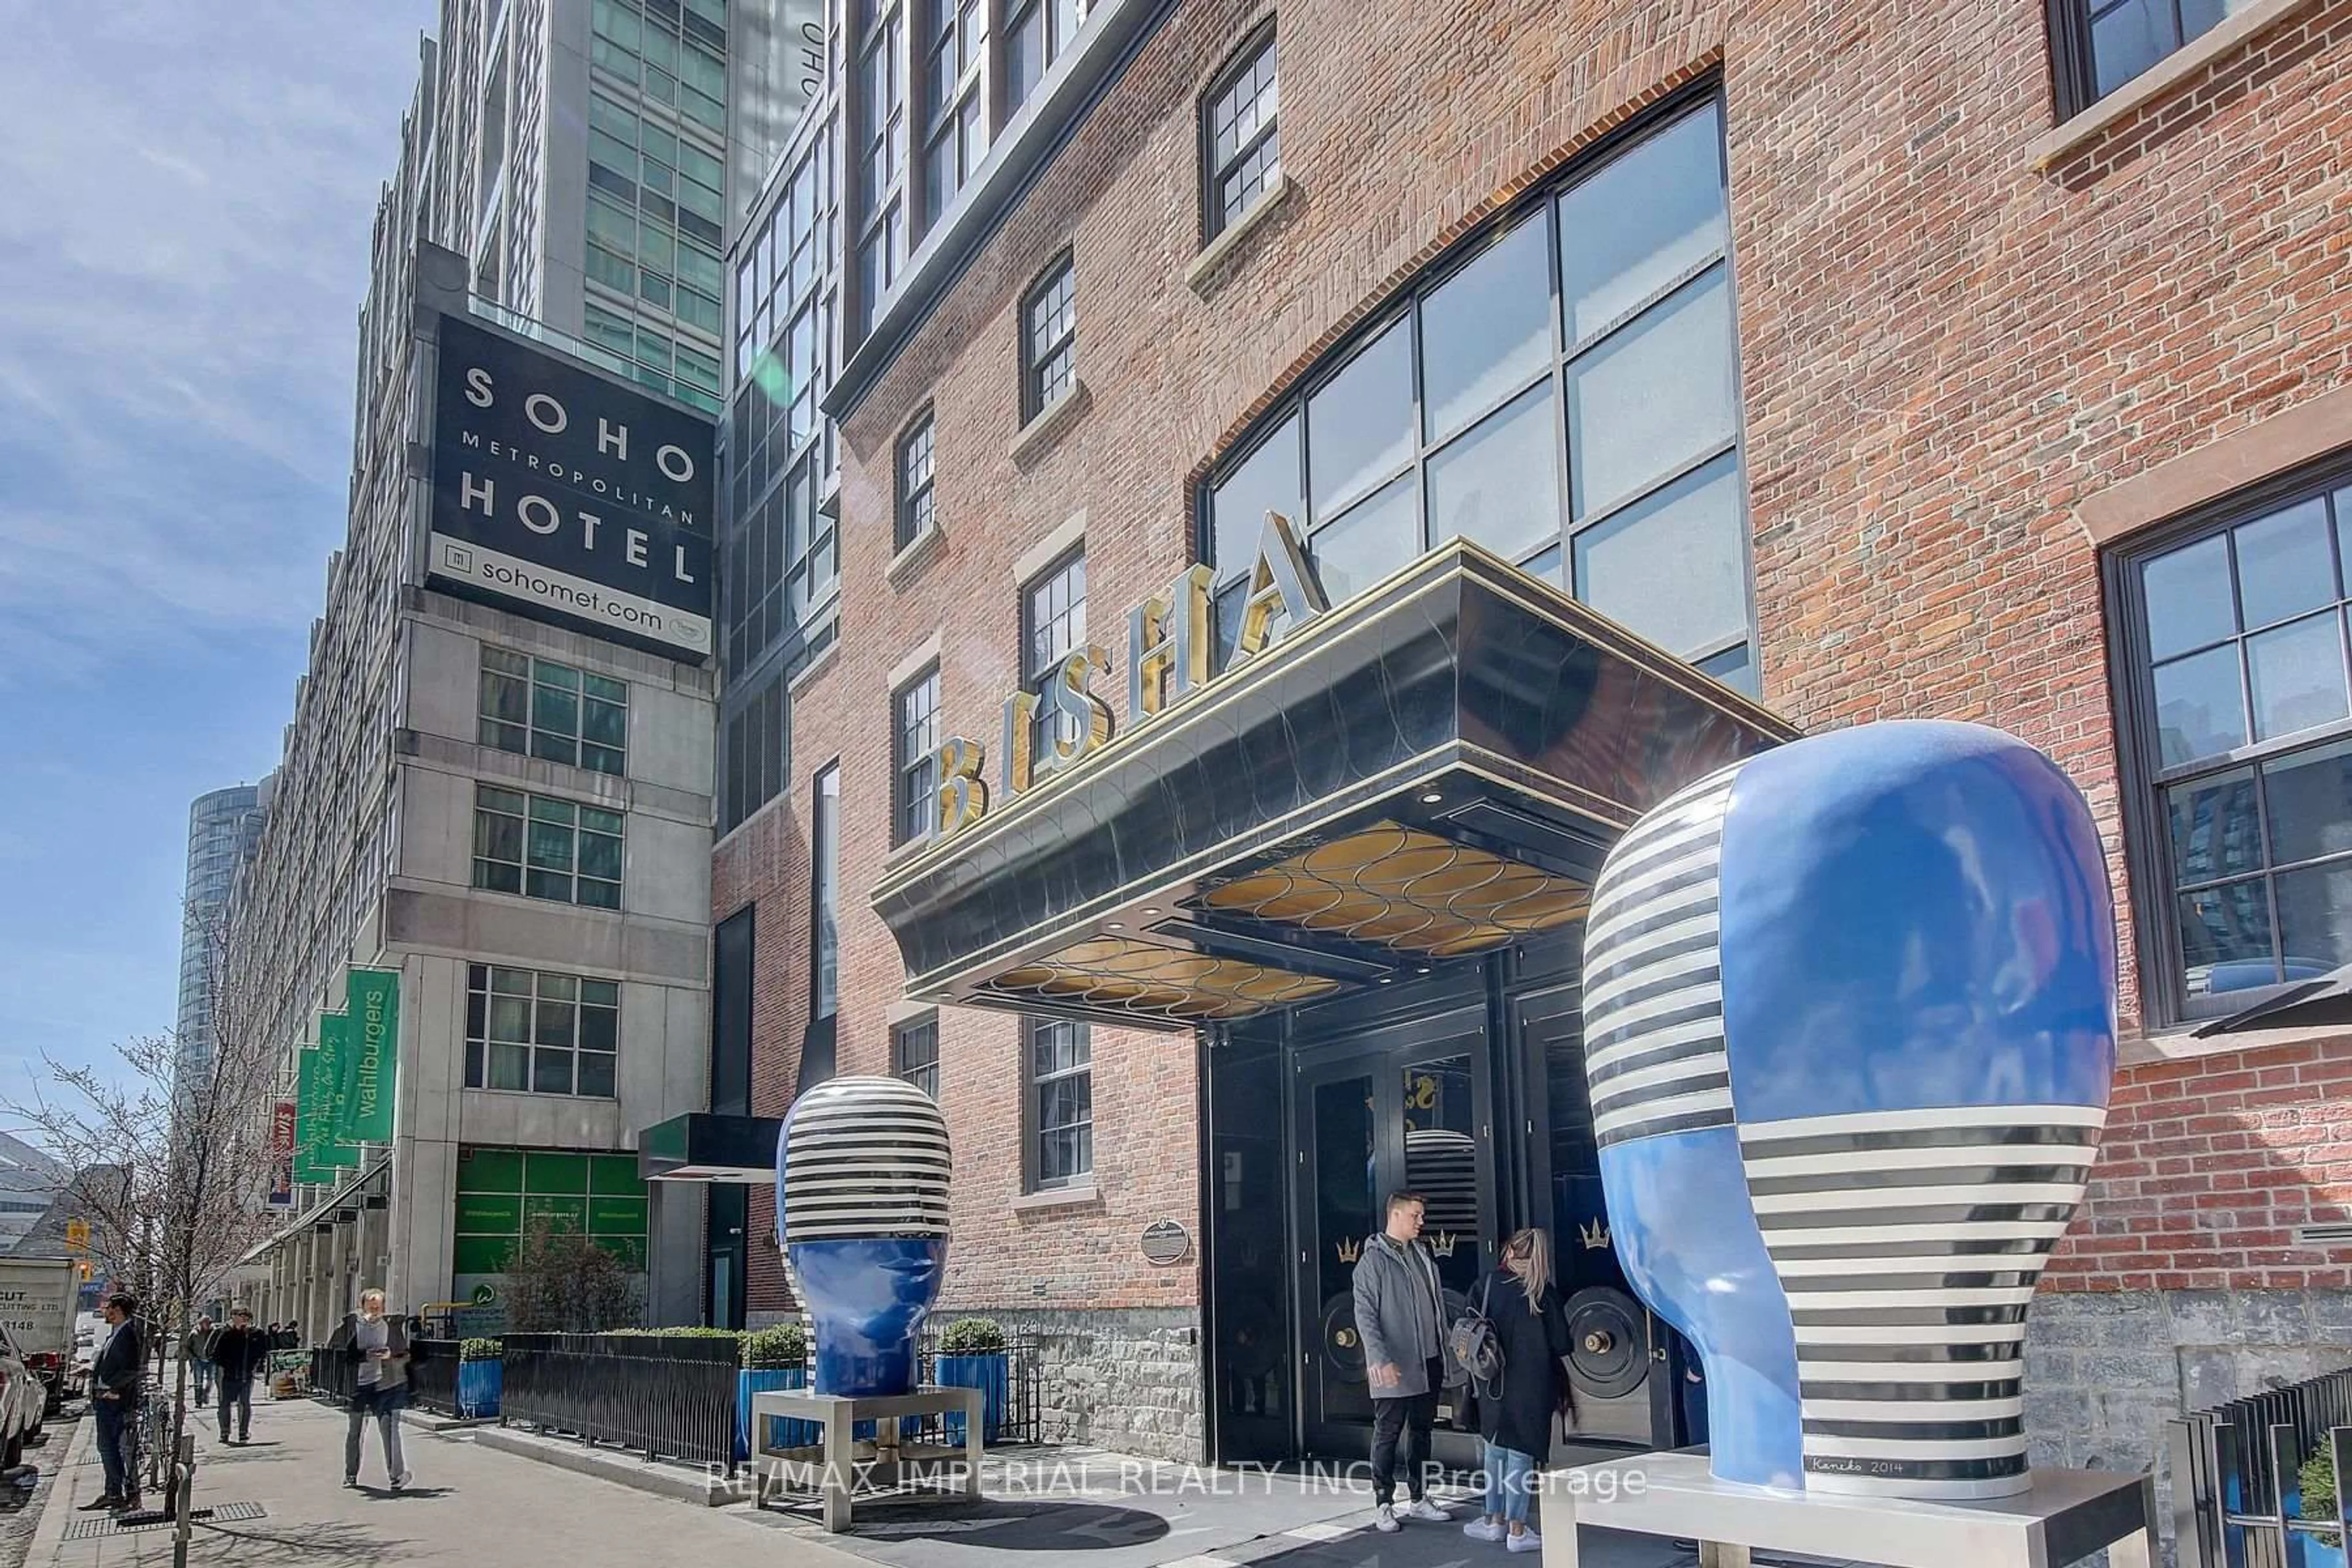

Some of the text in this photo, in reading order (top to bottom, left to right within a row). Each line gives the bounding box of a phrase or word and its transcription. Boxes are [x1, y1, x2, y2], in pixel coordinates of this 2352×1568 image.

[462, 431, 693, 524] METROPOLITAN
[465, 368, 694, 483] SOHO
[461, 472, 694, 584] HOTEL
[482, 560, 662, 630] sohomet.com
[927, 509, 1332, 841] BISHA
[358, 990, 386, 1118] wahlburgers
[1812, 1457, 1904, 1473] Kaneko 2014
